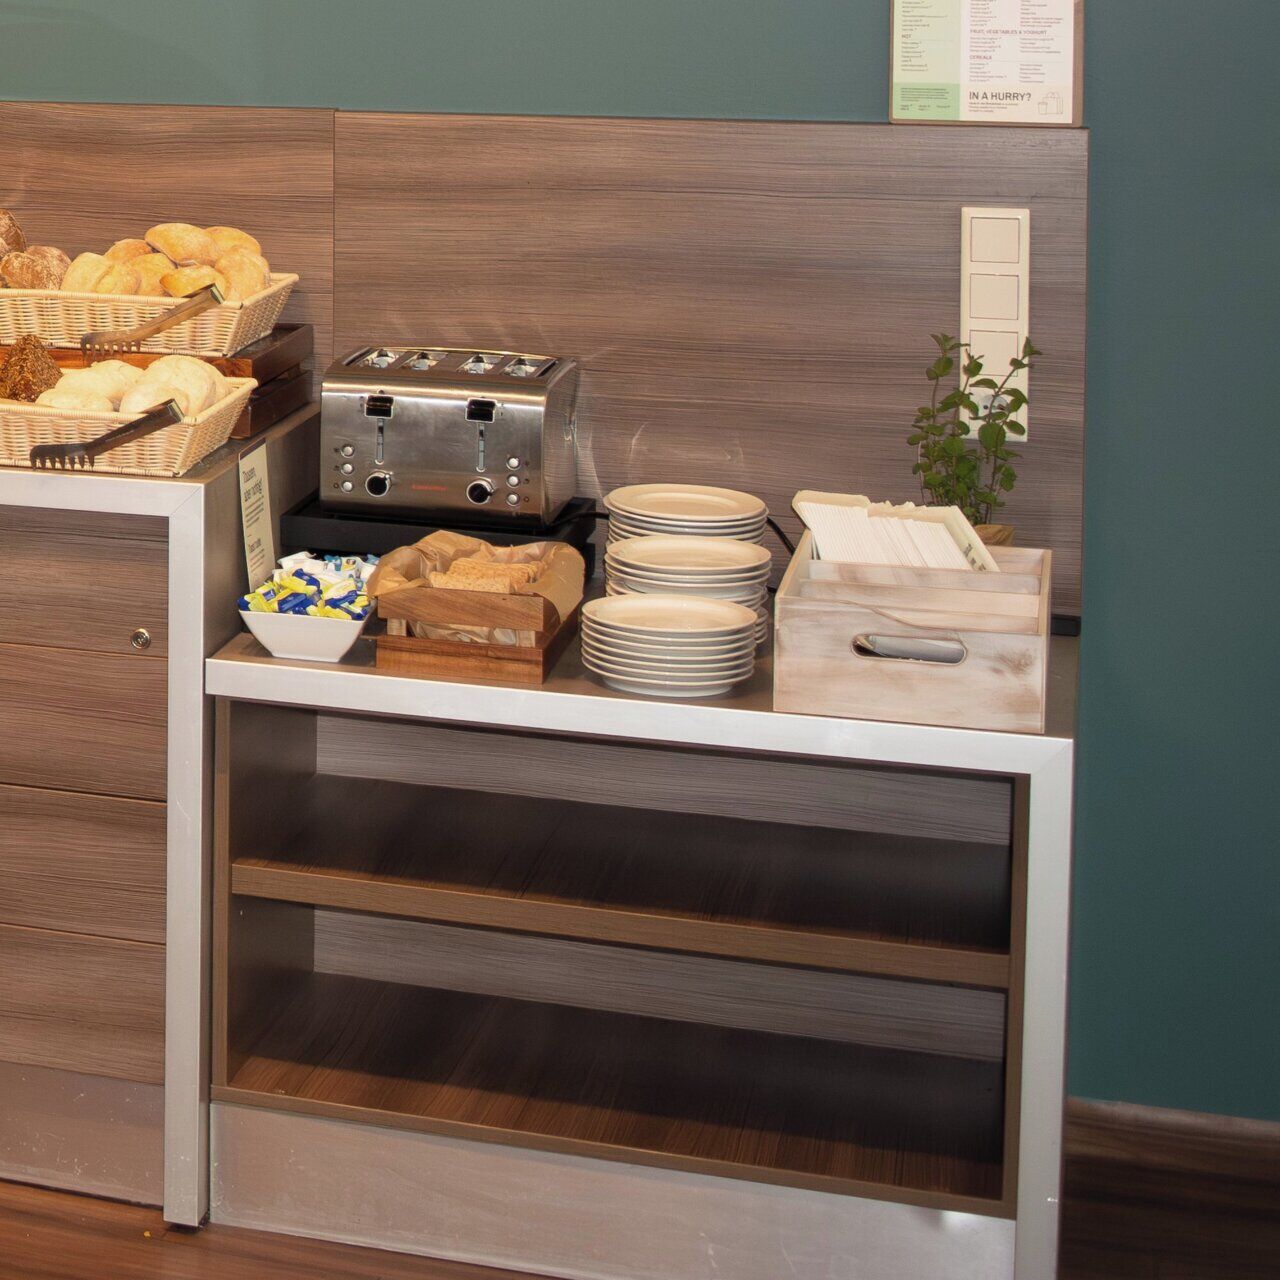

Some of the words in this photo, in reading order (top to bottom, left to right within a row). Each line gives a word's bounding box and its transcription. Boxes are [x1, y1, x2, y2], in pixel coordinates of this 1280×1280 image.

[969, 91, 980, 101] IN
[981, 92, 989, 101] A
[991, 92, 1032, 102] HURRY?
